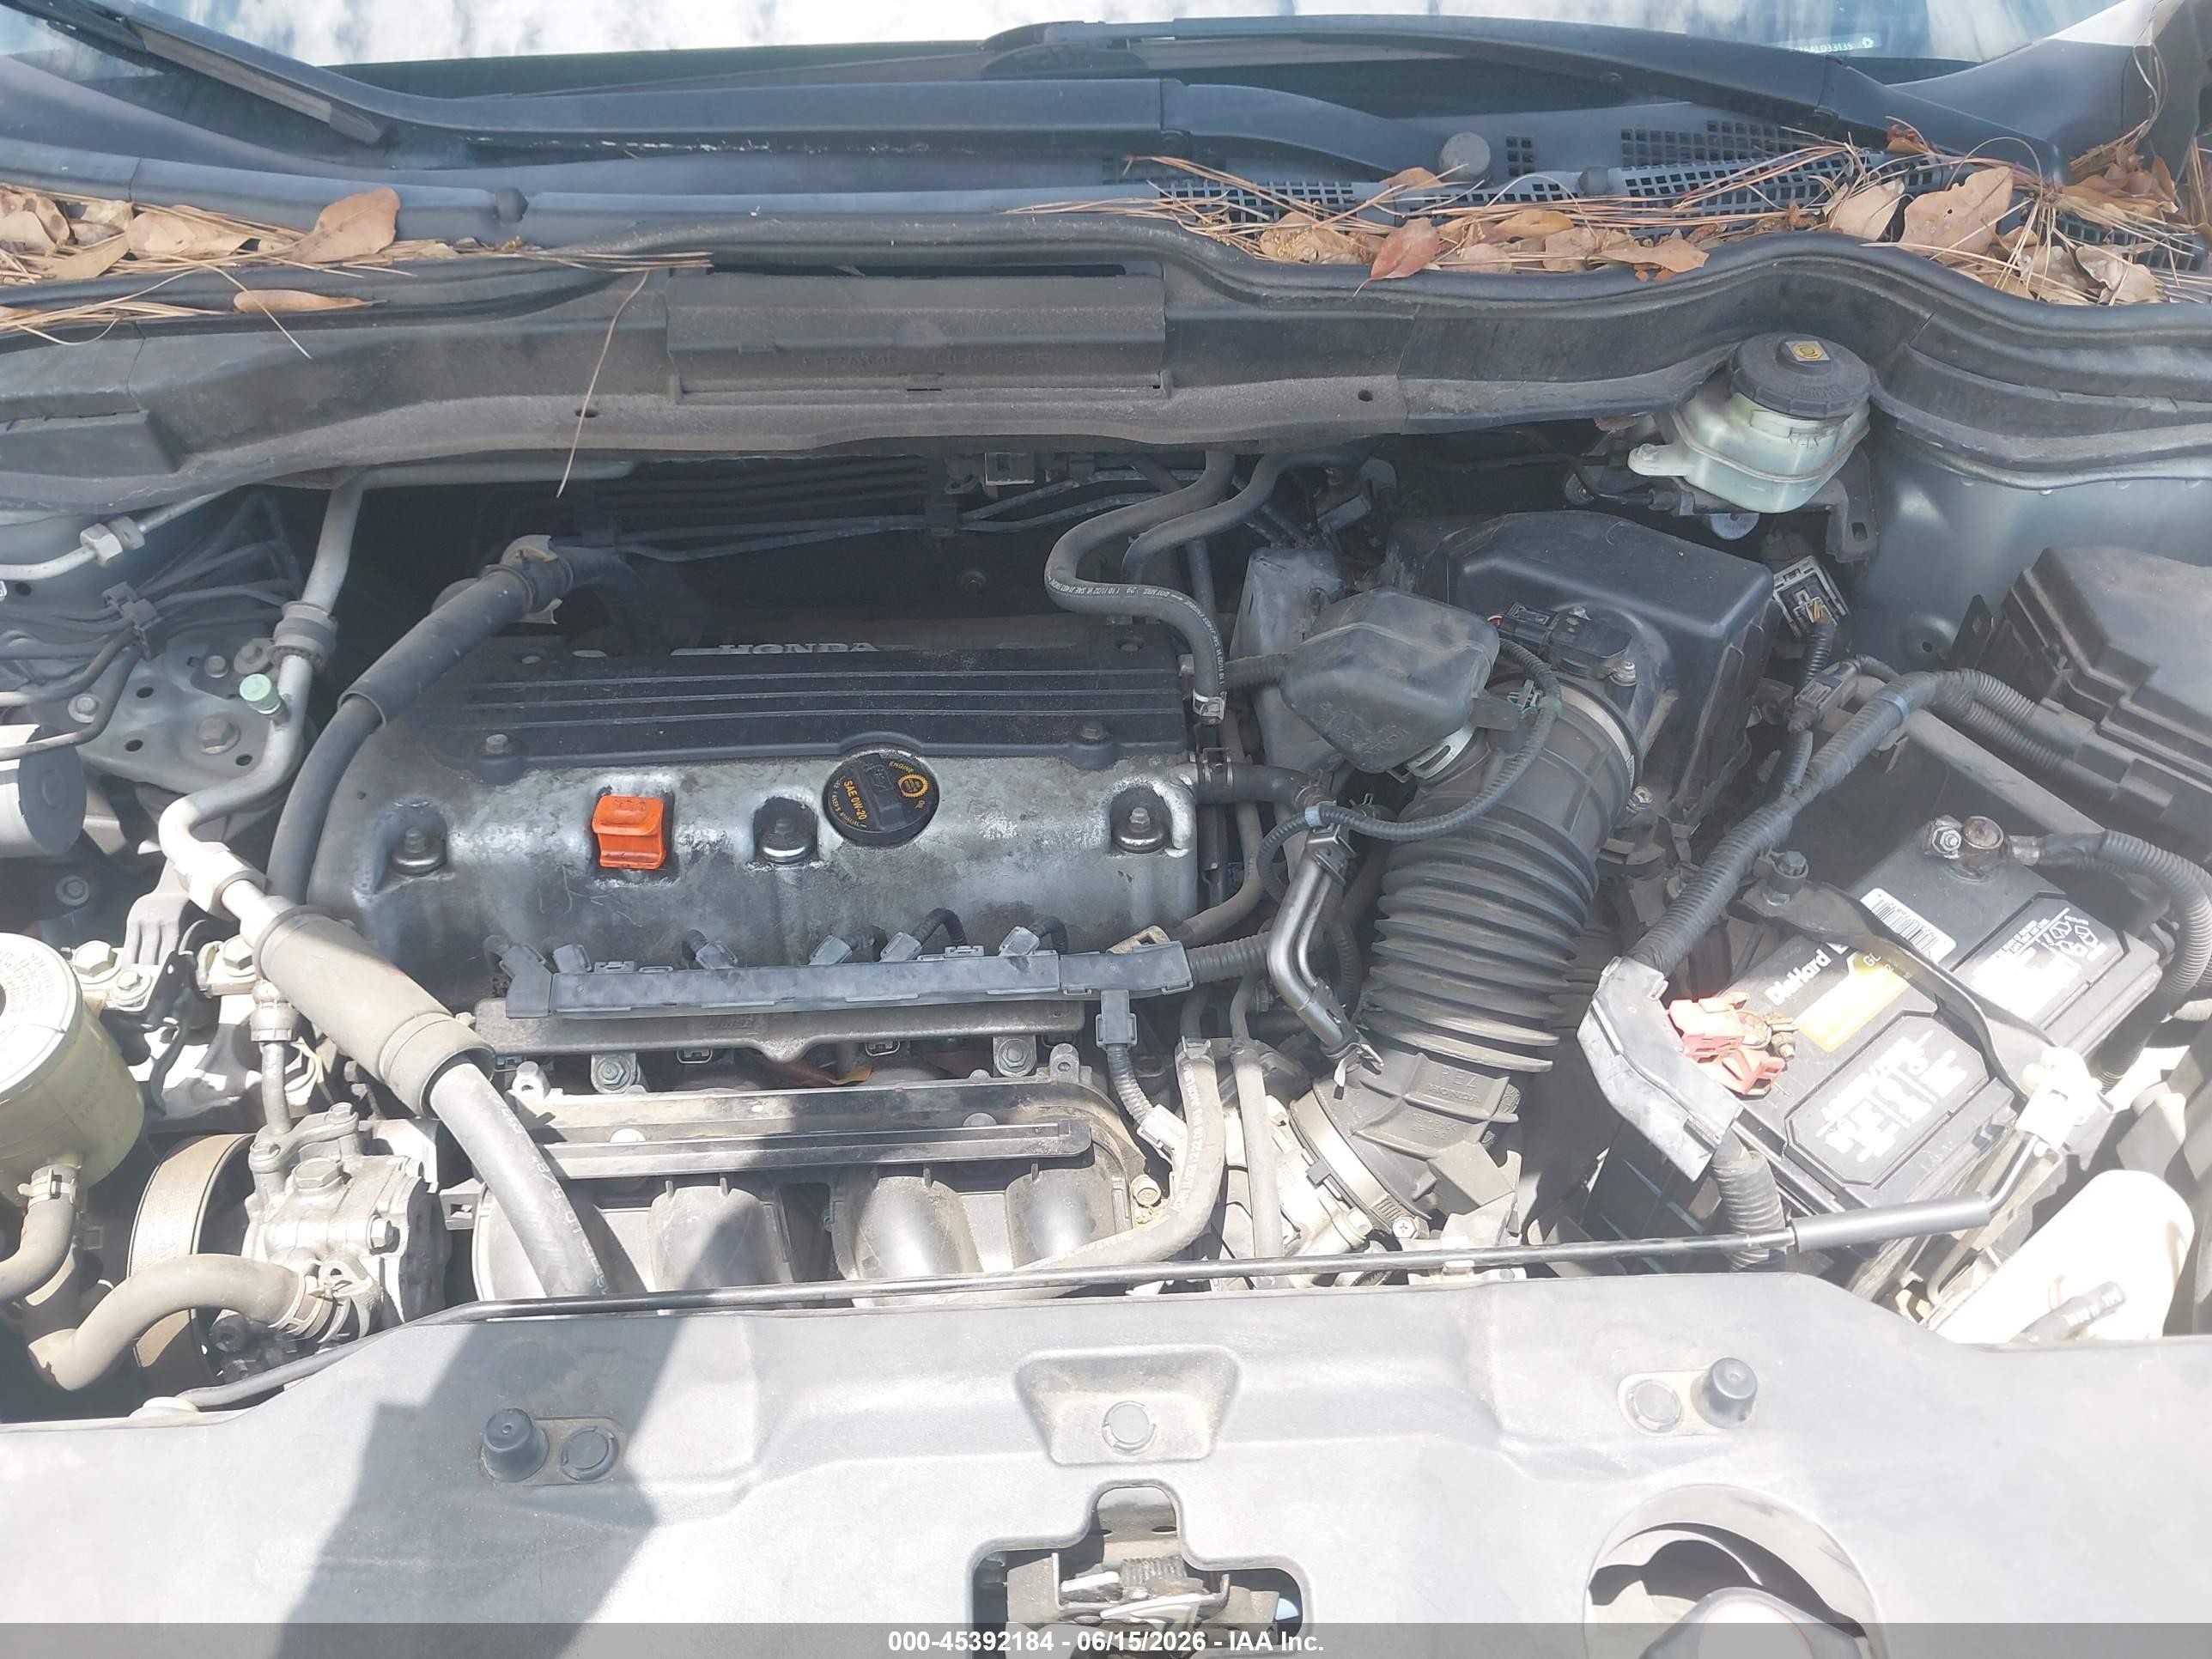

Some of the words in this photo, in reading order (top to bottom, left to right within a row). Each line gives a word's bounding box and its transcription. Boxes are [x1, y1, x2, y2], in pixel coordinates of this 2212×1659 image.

[718, 642, 880, 655] HONDA
[888, 761, 915, 774] ENGINE
[843, 779, 858, 798] SAE
[851, 797, 868, 820] 0W-20
[1765, 949, 1832, 1006] DieHard
[1428, 1083, 1482, 1106] HONDA
